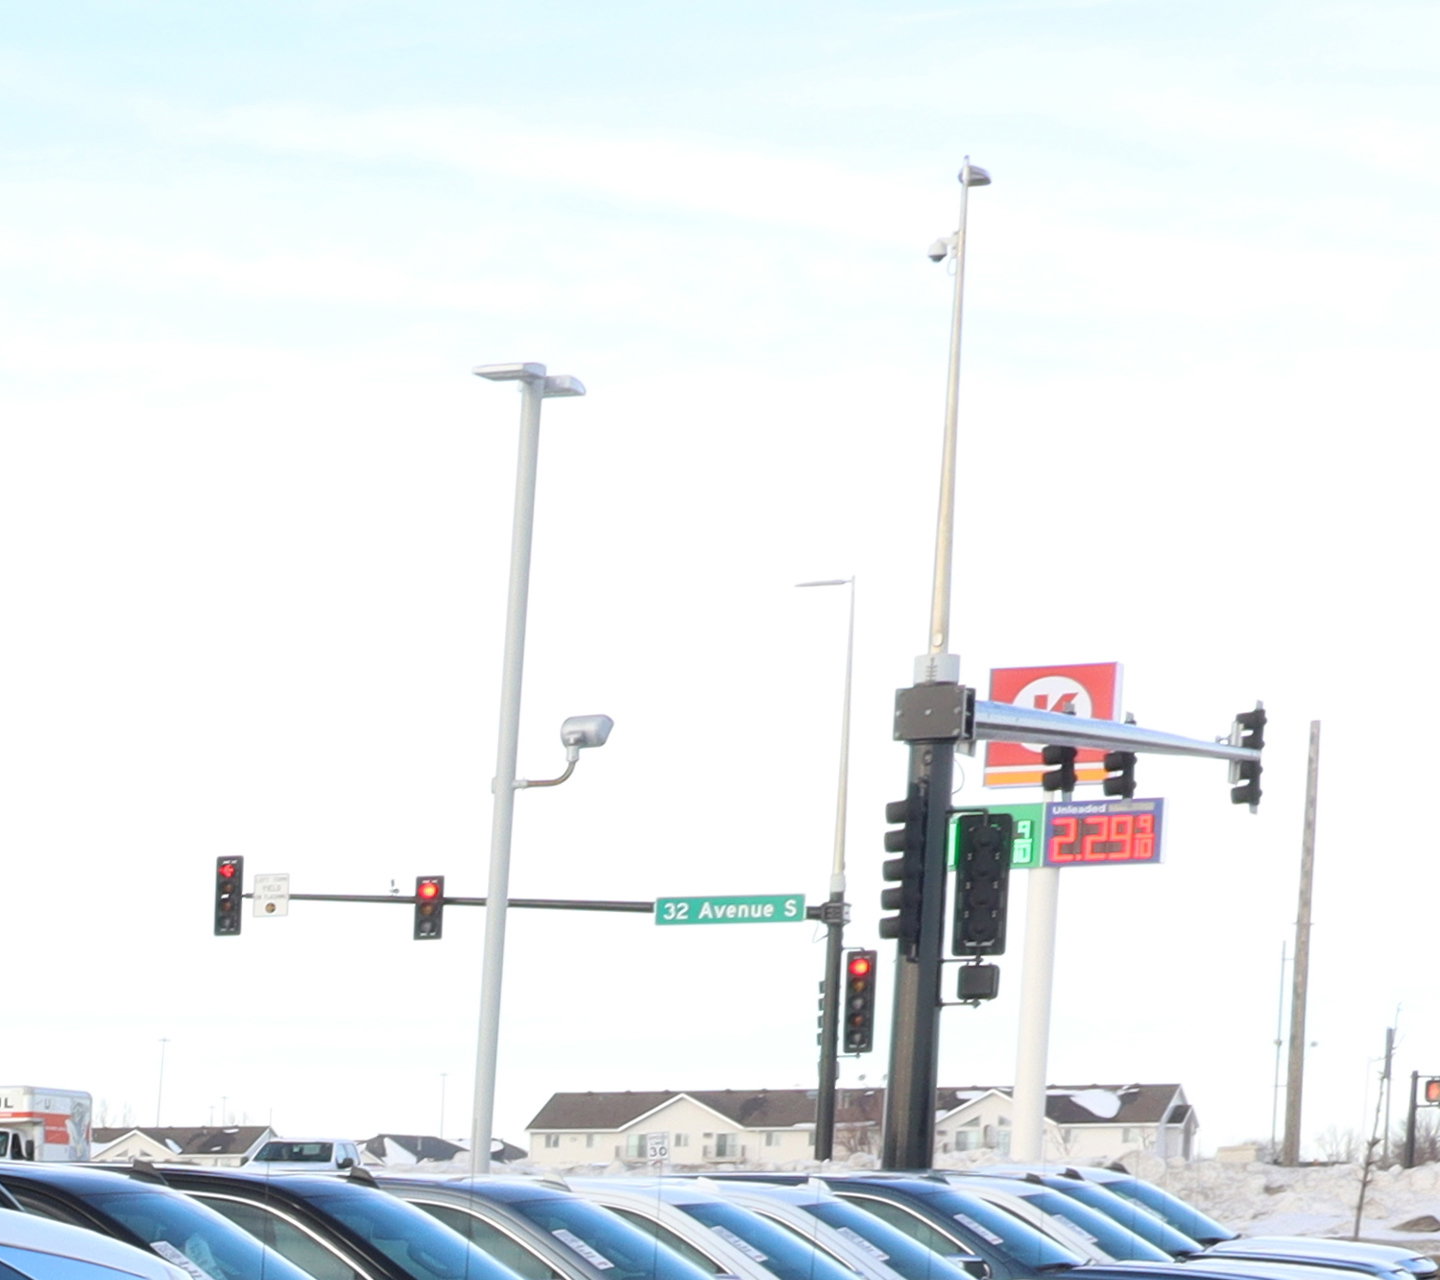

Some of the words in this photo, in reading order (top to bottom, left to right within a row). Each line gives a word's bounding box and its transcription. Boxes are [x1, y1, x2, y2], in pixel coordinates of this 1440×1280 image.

[1052, 804, 1107, 815] Unleaded
[1049, 815, 1132, 862] 2.29
[663, 902, 689, 920] 32
[698, 902, 774, 919] Avenue
[784, 899, 797, 917] S
[649, 1145, 668, 1158] 30
